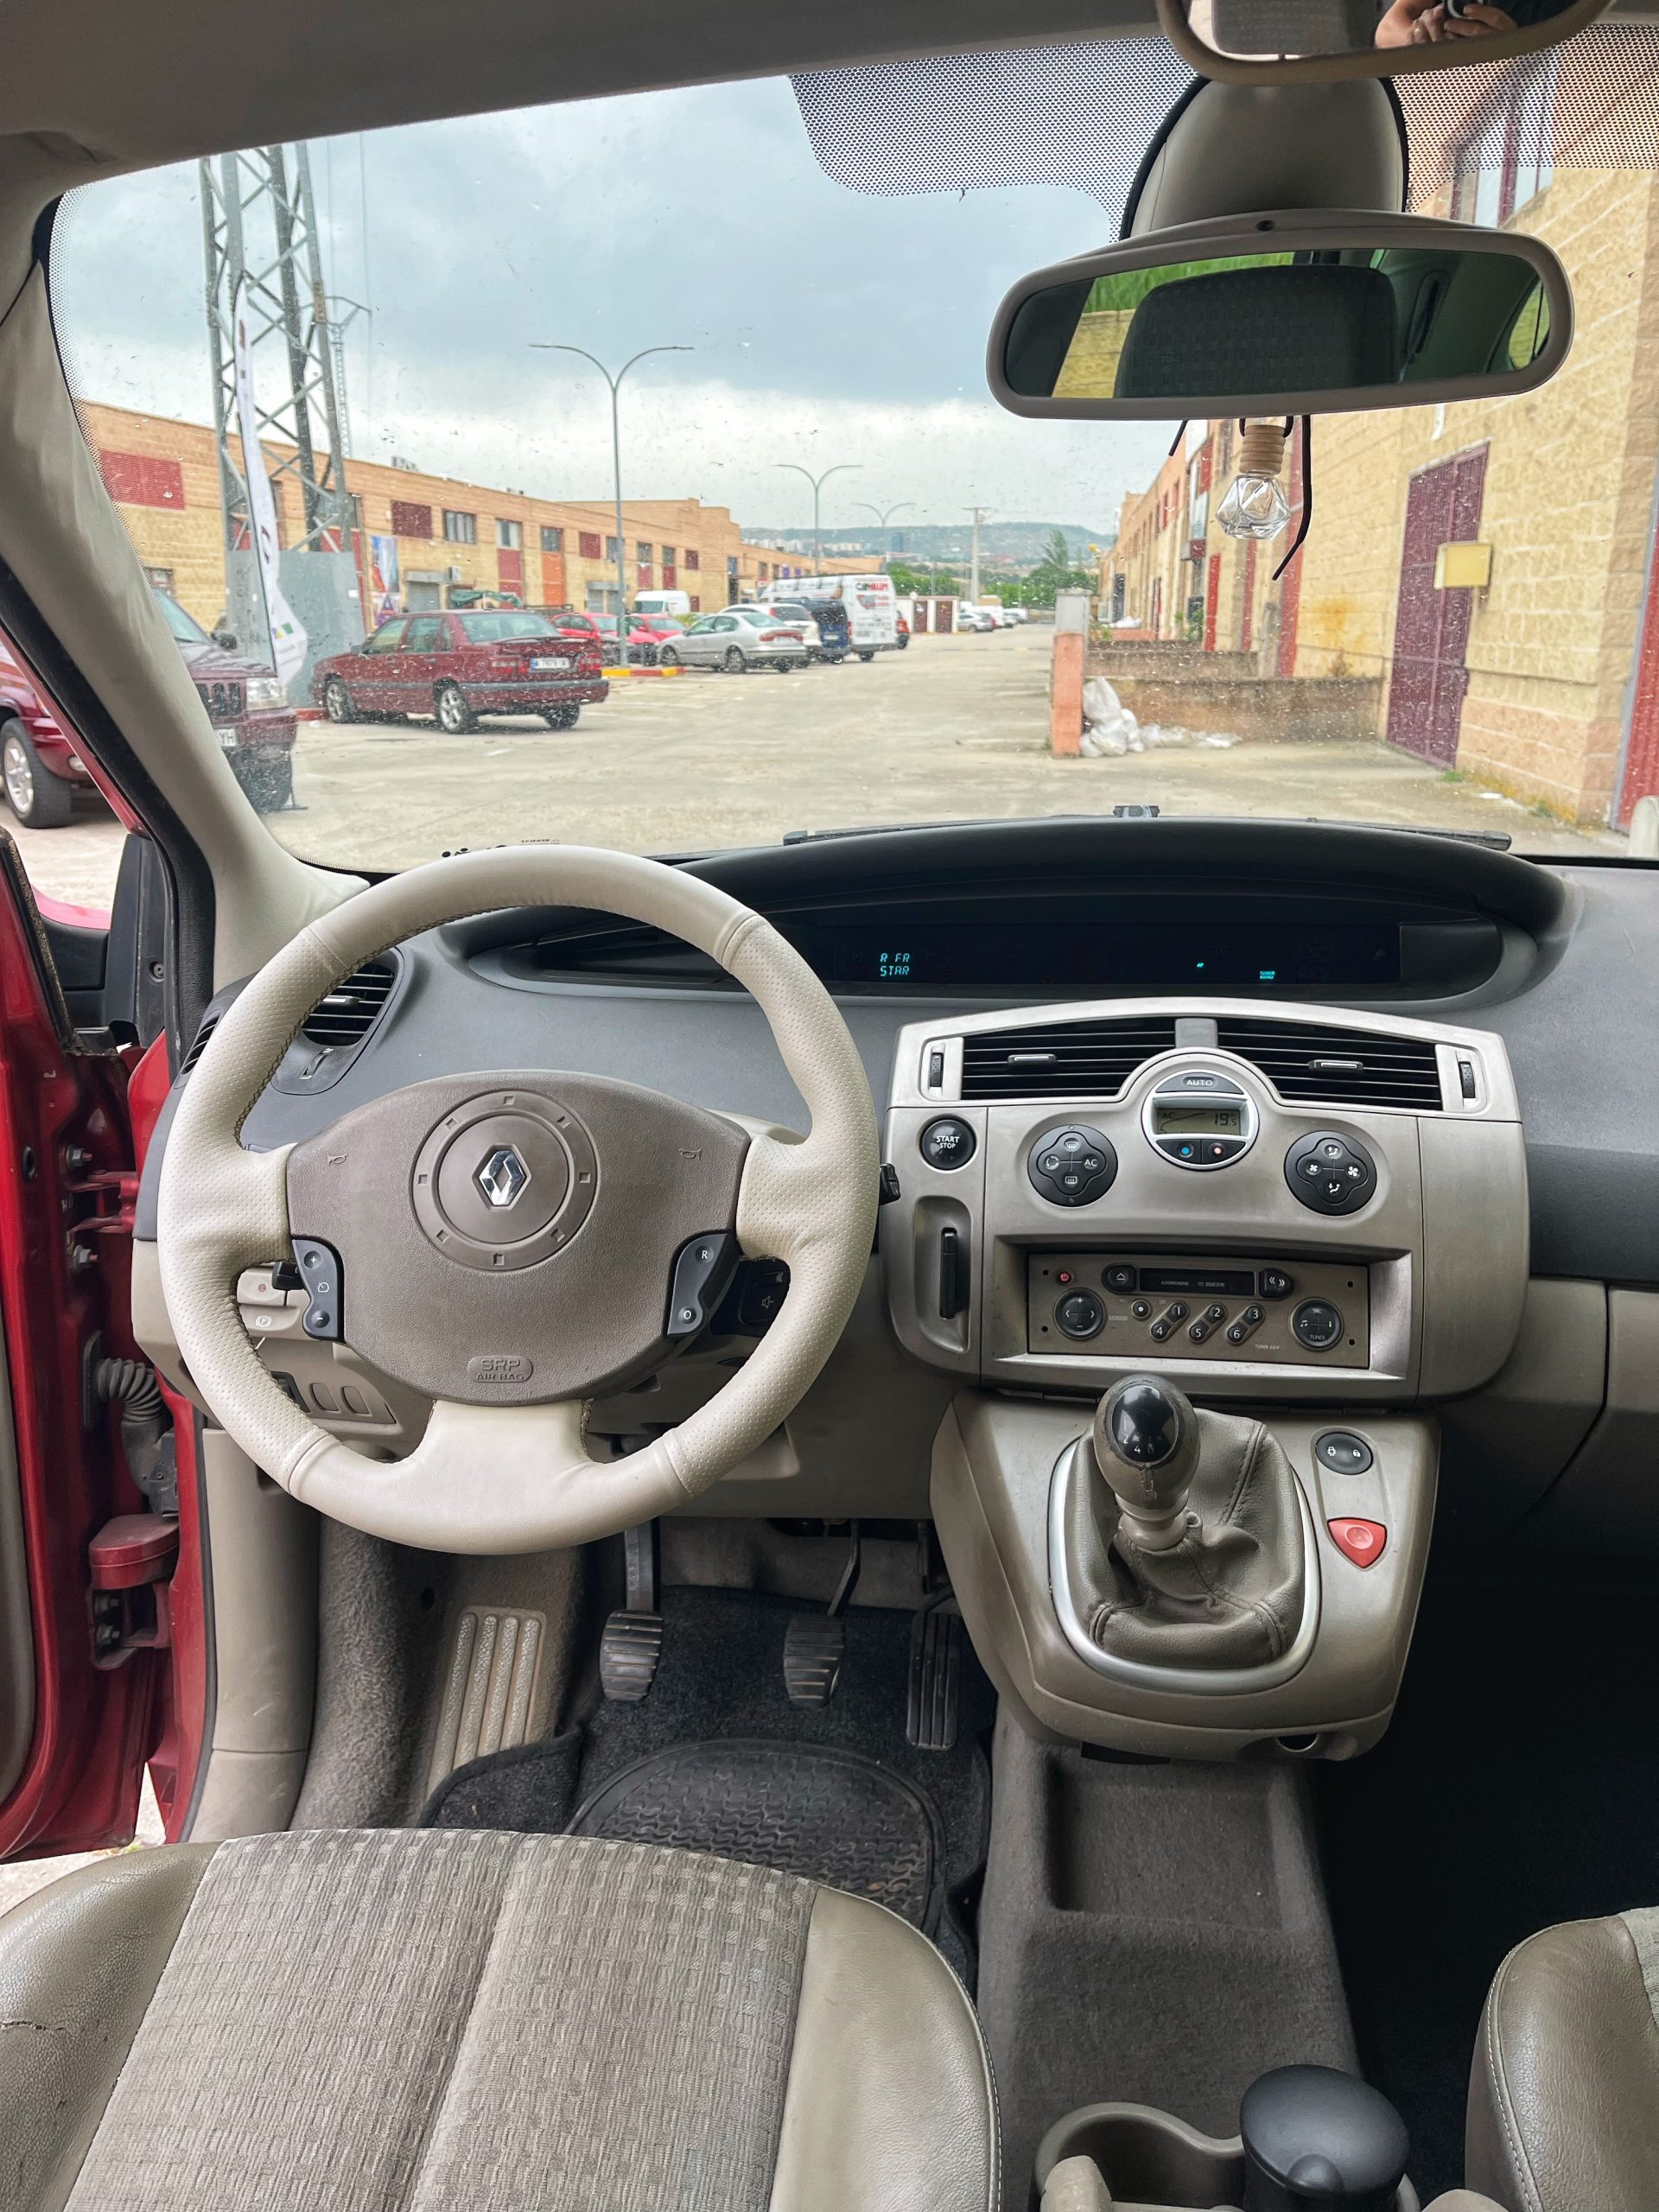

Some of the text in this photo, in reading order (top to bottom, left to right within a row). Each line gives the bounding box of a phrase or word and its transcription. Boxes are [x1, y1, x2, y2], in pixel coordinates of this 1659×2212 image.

[880, 953, 910, 963] R FR
[880, 965, 910, 976] STAR
[702, 1249, 709, 1259] R
[1214, 1308, 1220, 1317] 2
[1253, 1309, 1259, 1319] 3
[1156, 1326, 1240, 1338] 4 5 6
[481, 1358, 521, 1371] SRP
[499, 1372, 524, 1381] BAG
[1134, 1445, 1141, 1454] 4
